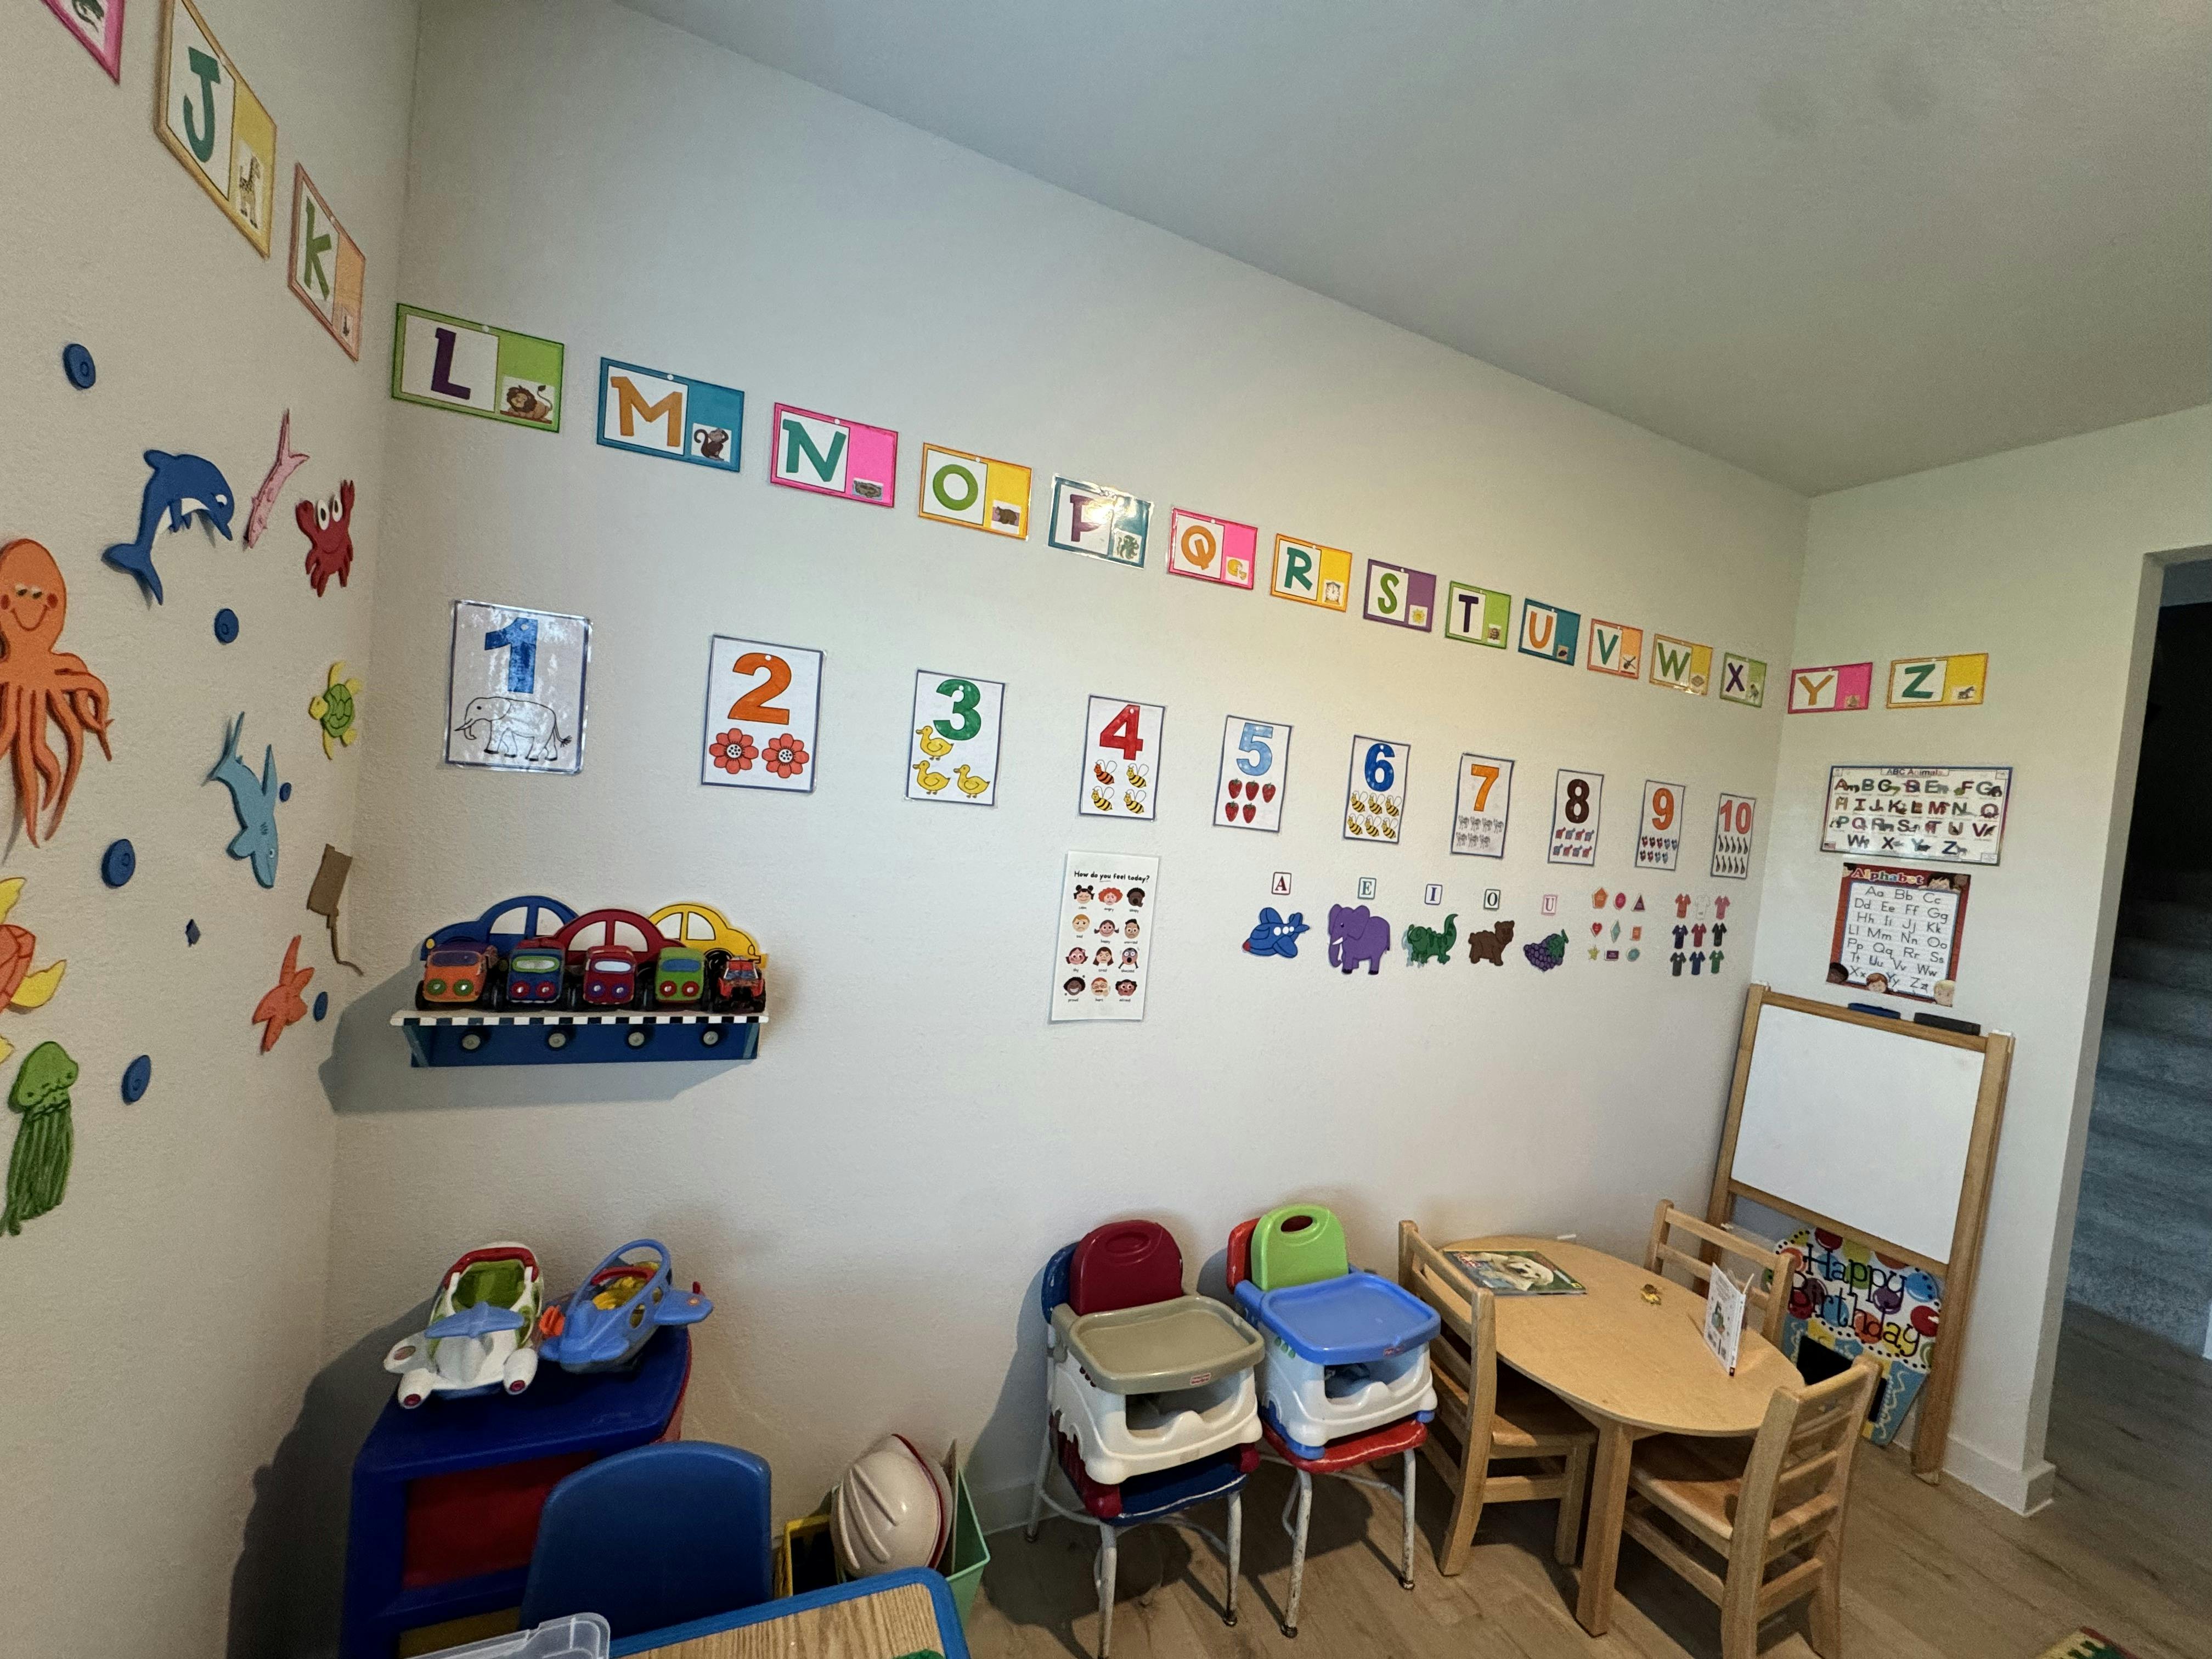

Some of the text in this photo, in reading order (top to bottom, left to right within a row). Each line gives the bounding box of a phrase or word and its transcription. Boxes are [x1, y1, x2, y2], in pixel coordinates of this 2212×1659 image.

[184, 47, 221, 162] J
[303, 196, 331, 301] K
[431, 328, 471, 400] L
[611, 376, 682, 447] M
[783, 419, 847, 482] N
[932, 464, 978, 511] O
[1070, 494, 1106, 542] P
[1181, 525, 1216, 570] Q
[1284, 547, 1312, 591] R
[1378, 573, 1400, 614] S
[1459, 594, 1479, 633] T
[1529, 611, 1553, 649] U
[484, 618, 538, 693] 1
[1598, 629, 1619, 665] V
[1658, 642, 1690, 681] W
[727, 652, 792, 725] 2
[1725, 662, 1745, 692] X
[1798, 675, 1833, 706] Y
[1902, 664, 1936, 698] Z
[933, 679, 981, 741] 3
[1099, 704, 1143, 760] 4
[1236, 723, 1274, 776] 5
[1364, 743, 1395, 792] 6
[1834, 779, 1848, 791] A
[1861, 778, 1875, 792] B
[1877, 779, 1892, 793] C
[1925, 780, 1939, 794] E
[1961, 781, 1974, 794] F
[1976, 781, 1993, 795] G
[1470, 764, 1499, 811] 7
[1565, 778, 1590, 823] 8
[1835, 797, 1848, 811] H
[1854, 798, 1866, 811] I
[1869, 799, 1880, 811] J
[1888, 800, 1903, 813] K
[1911, 801, 1922, 814] L
[1928, 802, 1947, 814] M
[1952, 802, 1967, 815] N
[1651, 788, 1674, 831] 9
[1720, 799, 1752, 834] 10
[1838, 816, 1988, 837] P Q R S T U V
[1848, 834, 1957, 855] W X Y Z
[1128, 874, 1150, 883] today?
[1275, 876, 1287, 891] A
[1362, 881, 1372, 895] E
[1428, 888, 1437, 902] I
[1851, 868, 1924, 884] Alphabet
[1865, 886, 1941, 904] Aa Bb Cc
[1487, 893, 1497, 906] O
[1544, 898, 1555, 911] U
[1854, 898, 1948, 924] Dd Ee Ff Gg
[1849, 924, 1947, 949] Ll Mm Nn Oo
[1857, 912, 1942, 933] Hh Ii Jj Kk
[1847, 938, 1944, 964] Pp Qq Rr Ss
[1850, 952, 1937, 977] Tt Uu Vv Ww
[1850, 966, 1866, 977] Xx
[1886, 972, 1899, 988] Yy
[1803, 1243, 1907, 1309] Happy
[1790, 1271, 1920, 1357] Birthday
